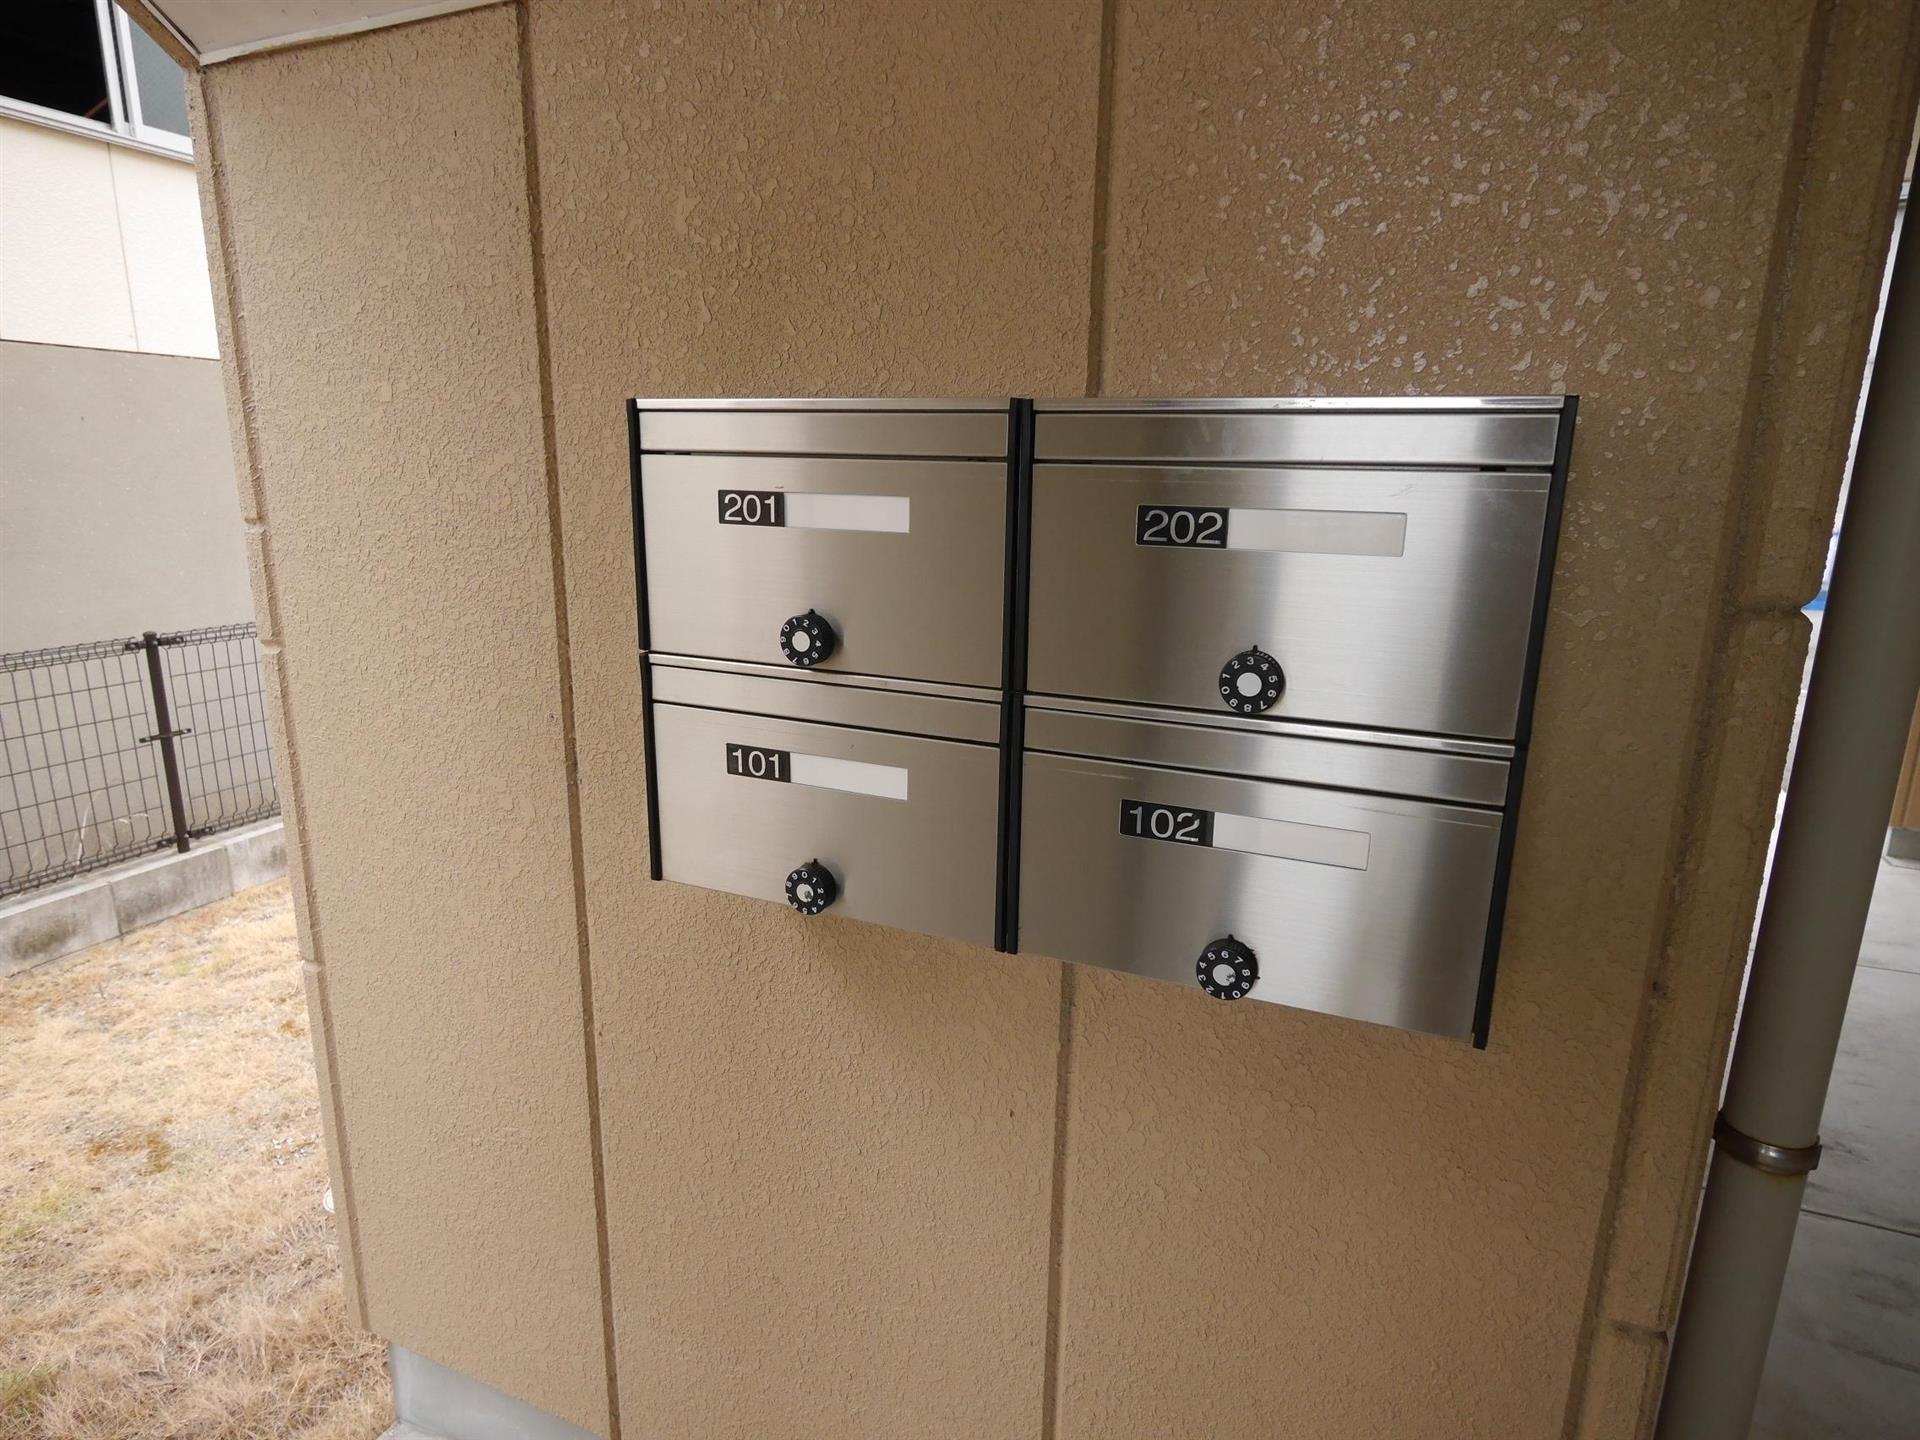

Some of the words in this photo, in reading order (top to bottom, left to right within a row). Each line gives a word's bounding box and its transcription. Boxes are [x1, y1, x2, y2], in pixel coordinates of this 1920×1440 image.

[724, 493, 775, 523] 201
[1143, 509, 1223, 545] 202
[1232, 661, 1240, 669] 2
[1261, 701, 1267, 709] 7
[732, 748, 780, 779] 101
[1129, 805, 1200, 843] 102
[1208, 952, 1215, 960] 5
